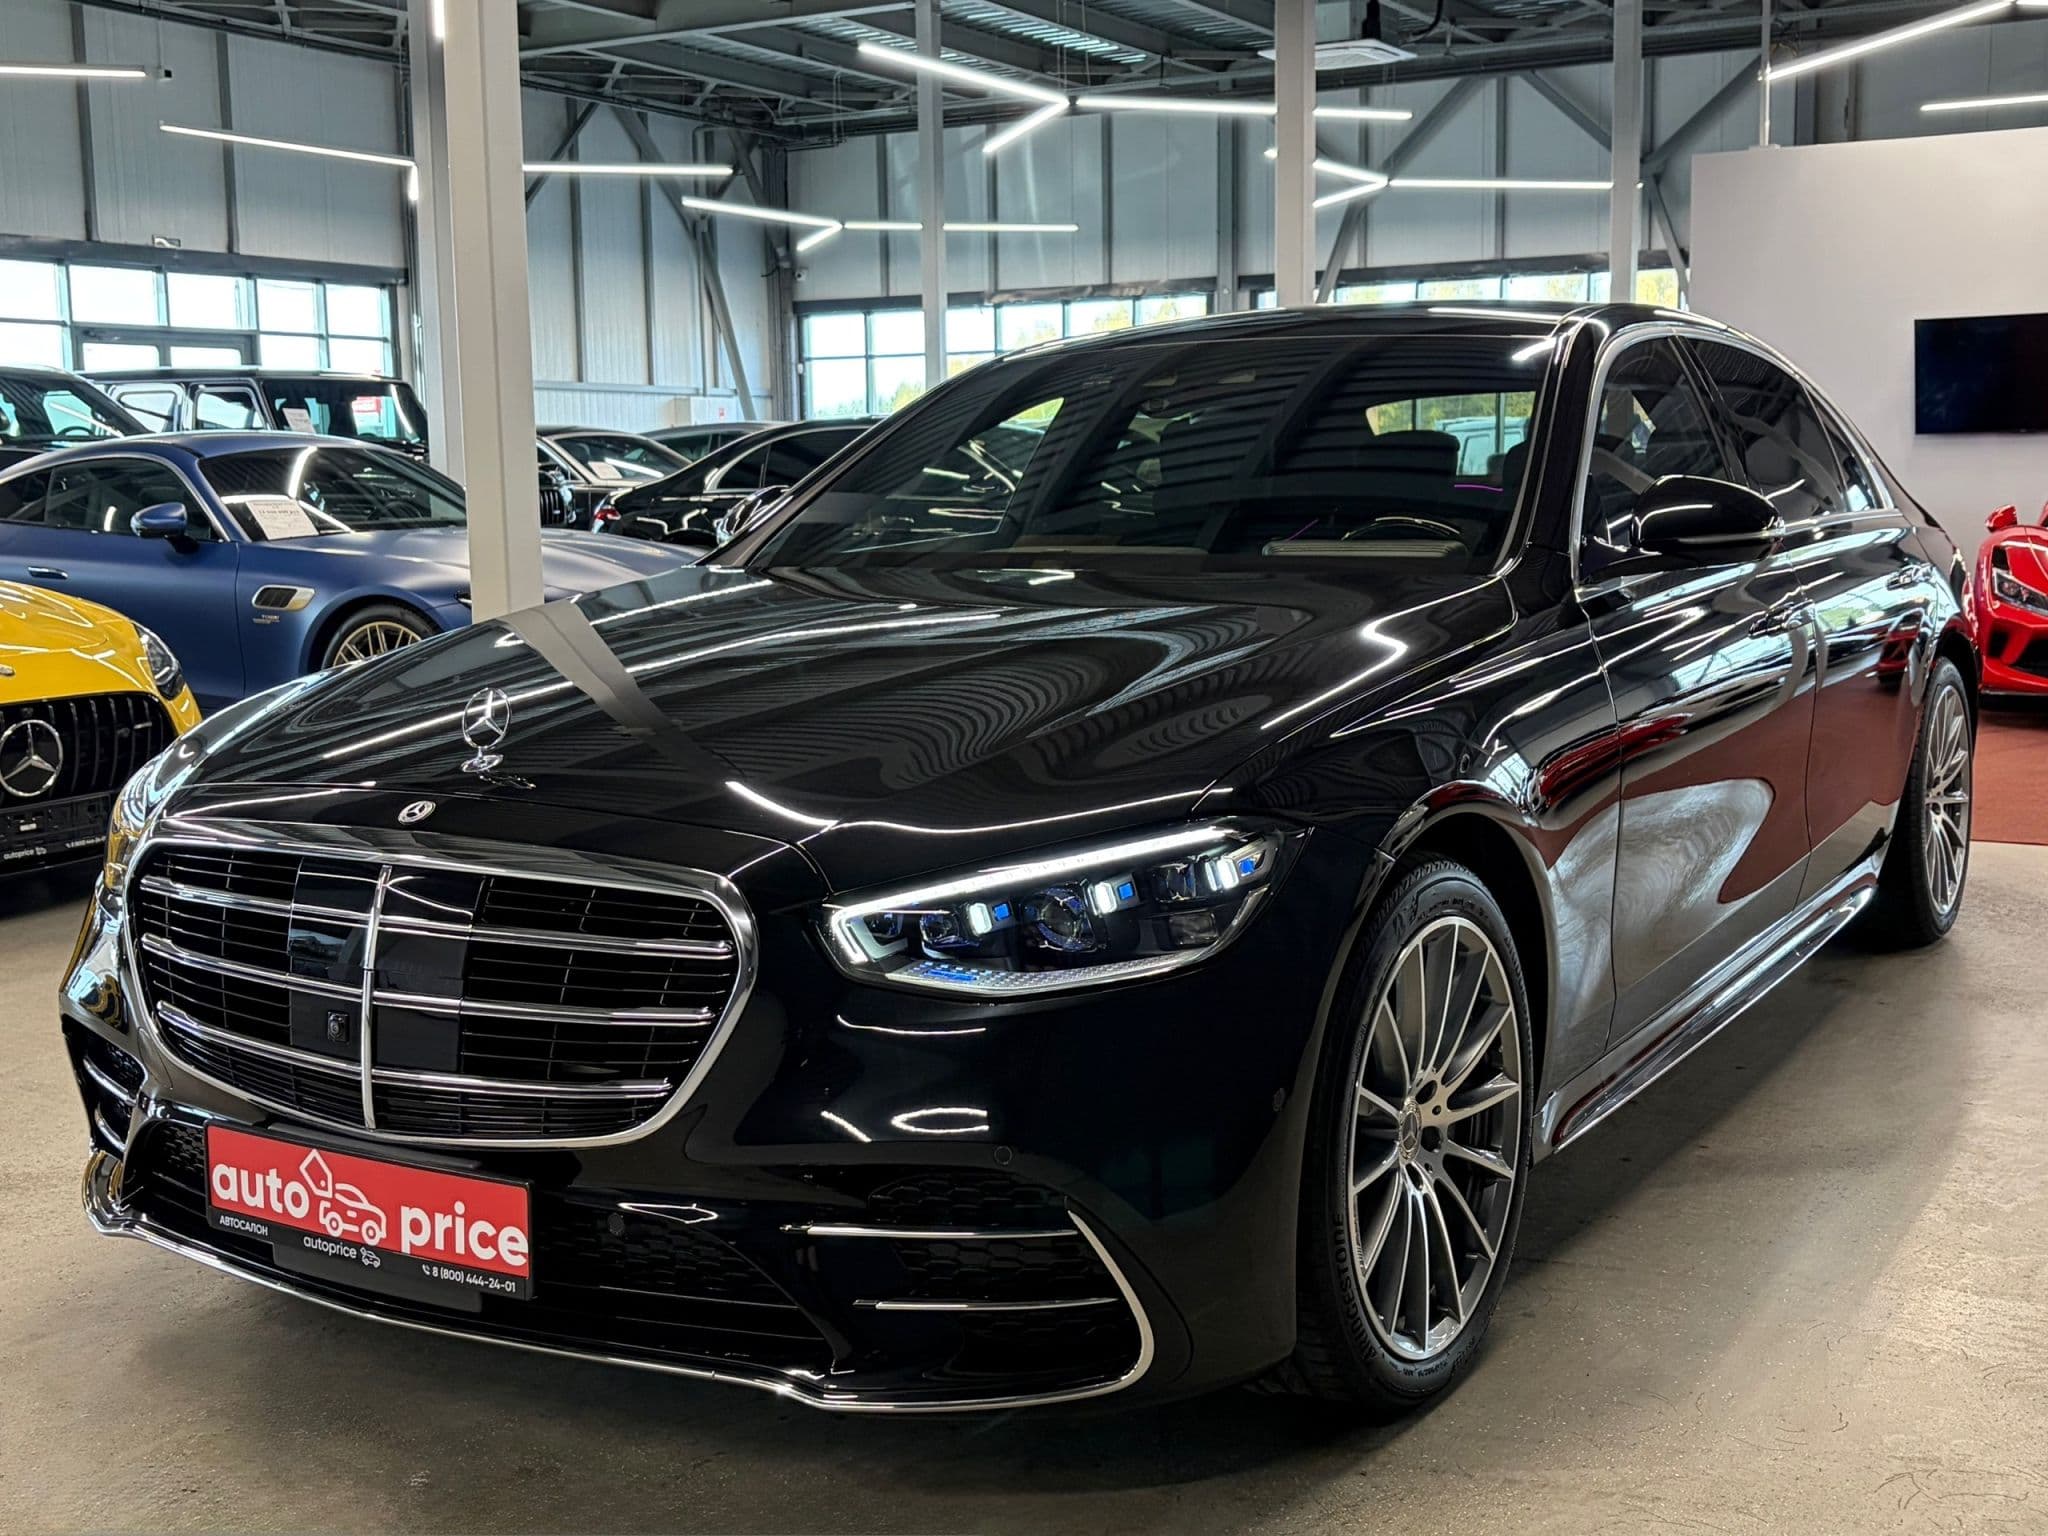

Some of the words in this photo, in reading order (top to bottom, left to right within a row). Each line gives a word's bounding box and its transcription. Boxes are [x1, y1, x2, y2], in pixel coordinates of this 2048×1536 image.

[212, 1163, 310, 1218] auto
[402, 1202, 527, 1266] price
[219, 1215, 268, 1236] АВТОСАЛОН
[303, 1236, 357, 1259] autoprice
[432, 1267, 439, 1277] 8
[440, 1268, 464, 1282] (800)
[466, 1273, 516, 1292] 444-24-01
